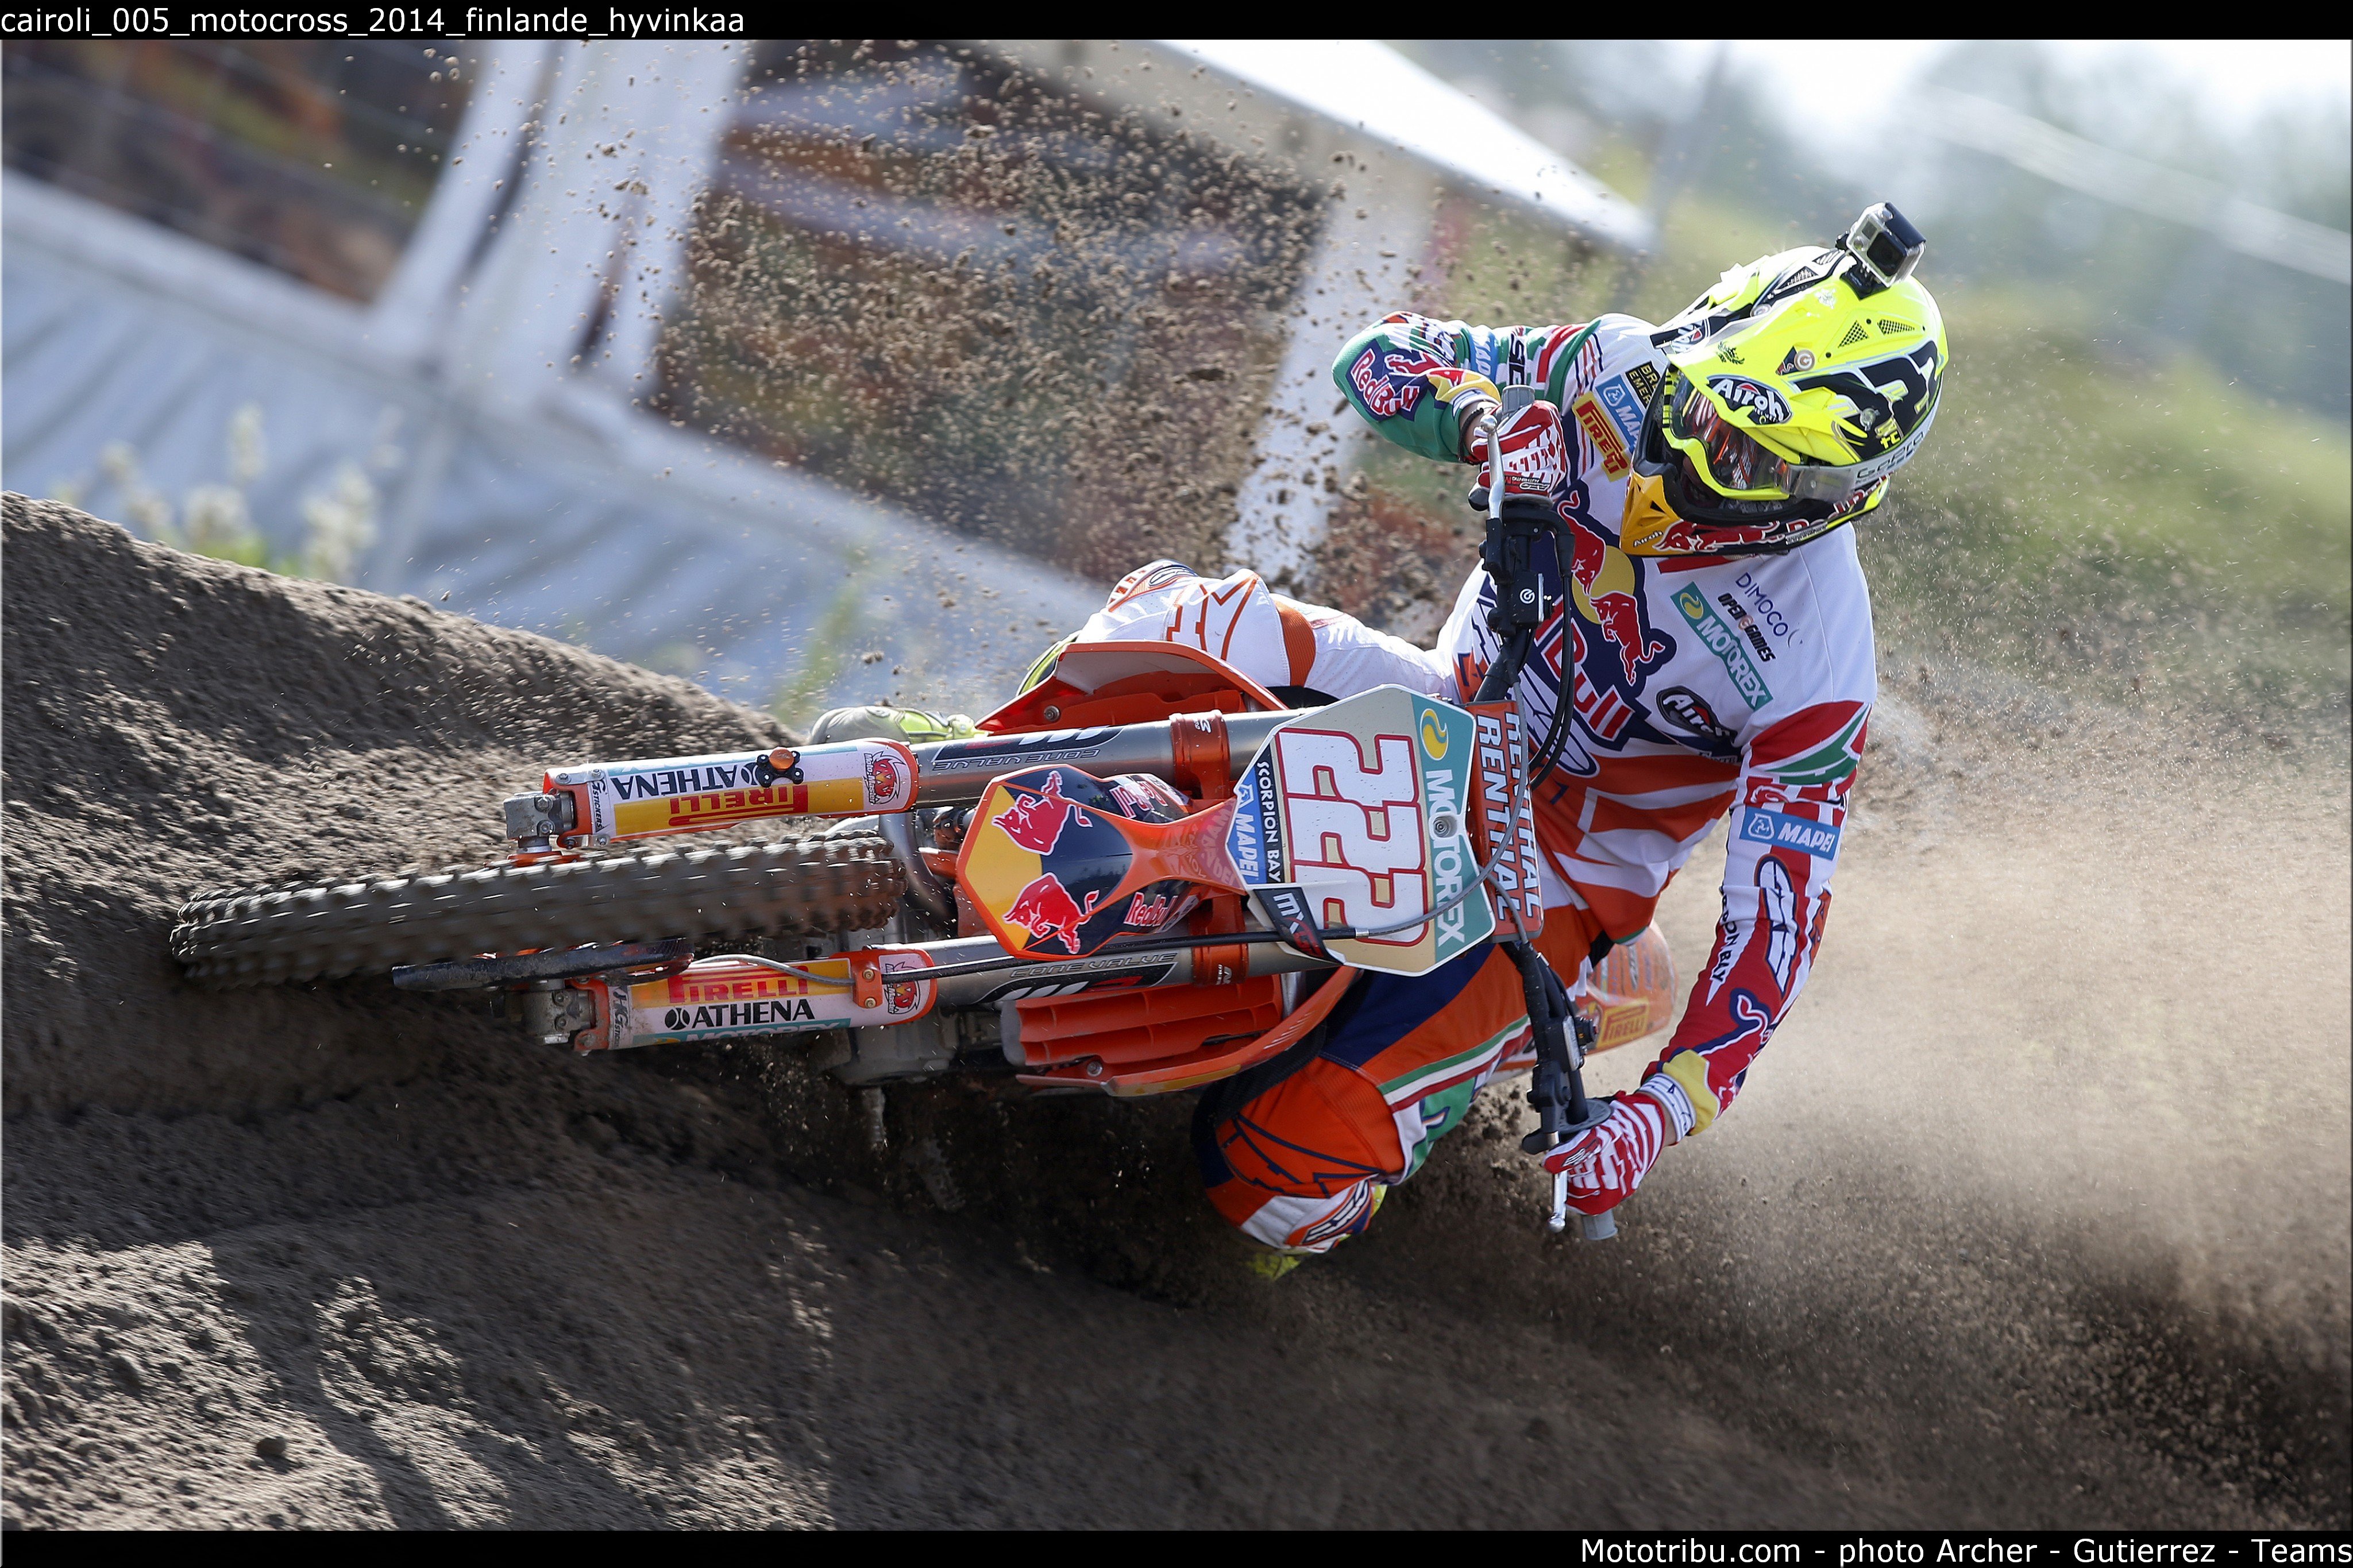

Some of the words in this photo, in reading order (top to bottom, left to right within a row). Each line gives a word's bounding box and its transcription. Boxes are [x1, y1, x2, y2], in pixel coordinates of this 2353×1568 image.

[1711, 378, 1784, 423] Airoh
[1633, 530, 1664, 547] Airoh
[1735, 571, 1789, 636] DIMOCO
[1696, 615, 1766, 708] MOTOREX
[932, 755, 1022, 772] VALVE
[1027, 749, 1100, 764] CONE
[611, 764, 737, 800] ATHENA
[1257, 760, 1279, 843] SCORPION
[592, 790, 603, 830] STICKERS
[668, 784, 808, 827] PIRELLI
[1477, 715, 1521, 921] RENTHAL
[1235, 812, 1260, 878] MAPEI
[1275, 727, 1428, 947] 222
[1777, 821, 1835, 853] MAPEI
[1266, 847, 1282, 883] BAY
[1424, 768, 1466, 948] MOTOREX
[667, 965, 809, 1003] PIRELLI
[1010, 962, 1085, 978] CONE
[1089, 952, 1178, 969] VALVE
[691, 999, 816, 1029] ATHENA
[1602, 1005, 1648, 1042] PIRELLI
